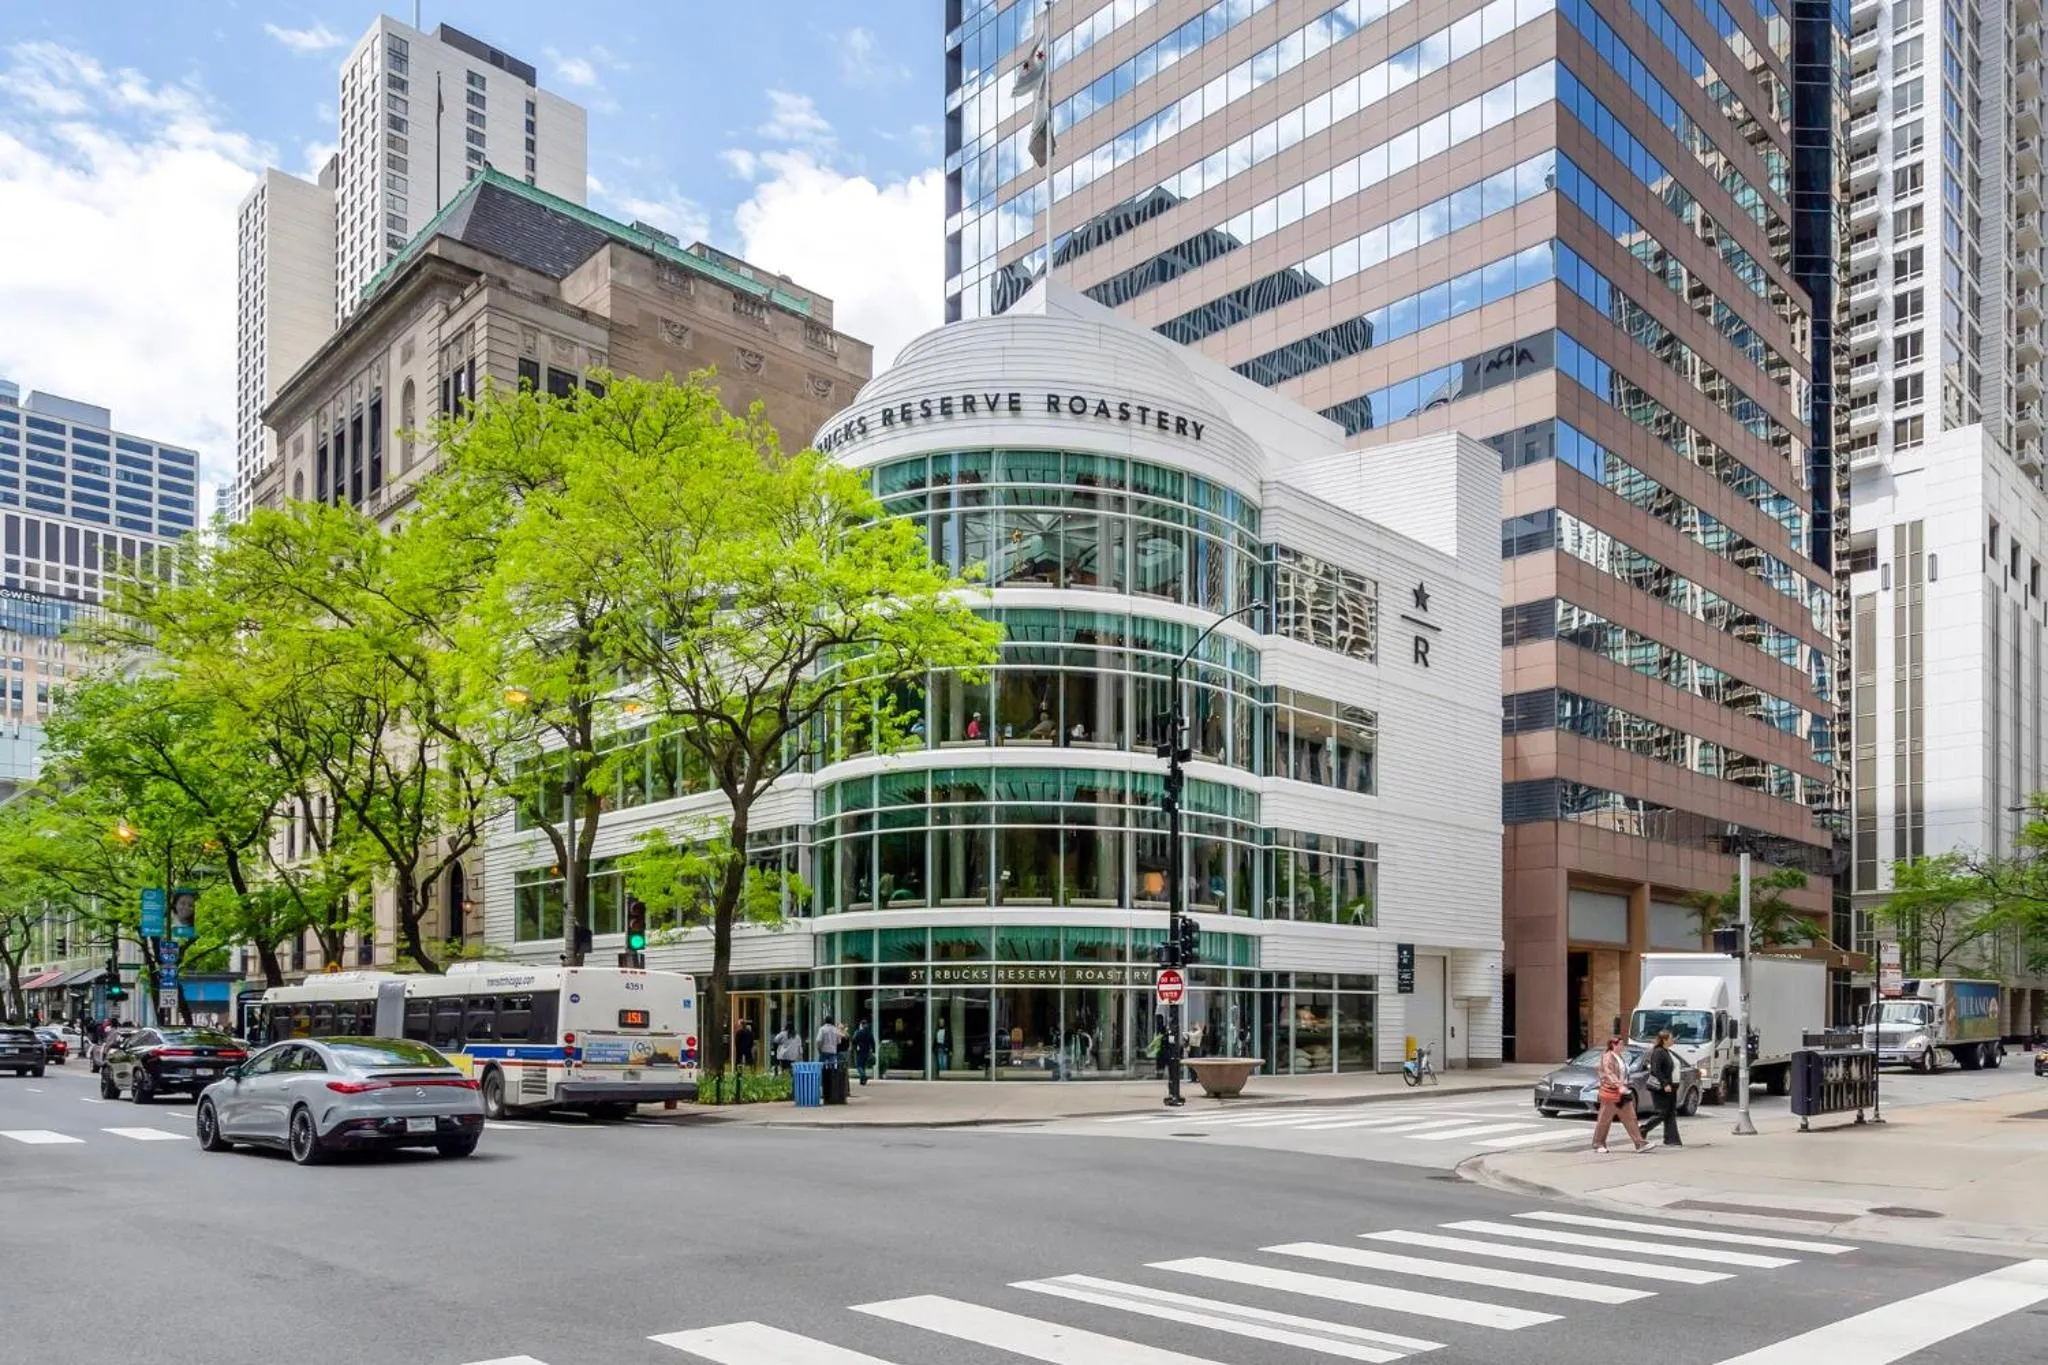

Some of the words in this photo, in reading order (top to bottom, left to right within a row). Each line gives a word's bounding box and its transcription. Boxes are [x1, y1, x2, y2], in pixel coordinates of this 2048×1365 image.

[882, 393, 1022, 427] RESERVE
[1047, 394, 1205, 440] ROASTERY
[1414, 635, 1430, 668] R
[911, 969, 989, 980] STRBUCKS
[625, 982, 644, 991] 4351
[627, 1012, 642, 1024] 151
